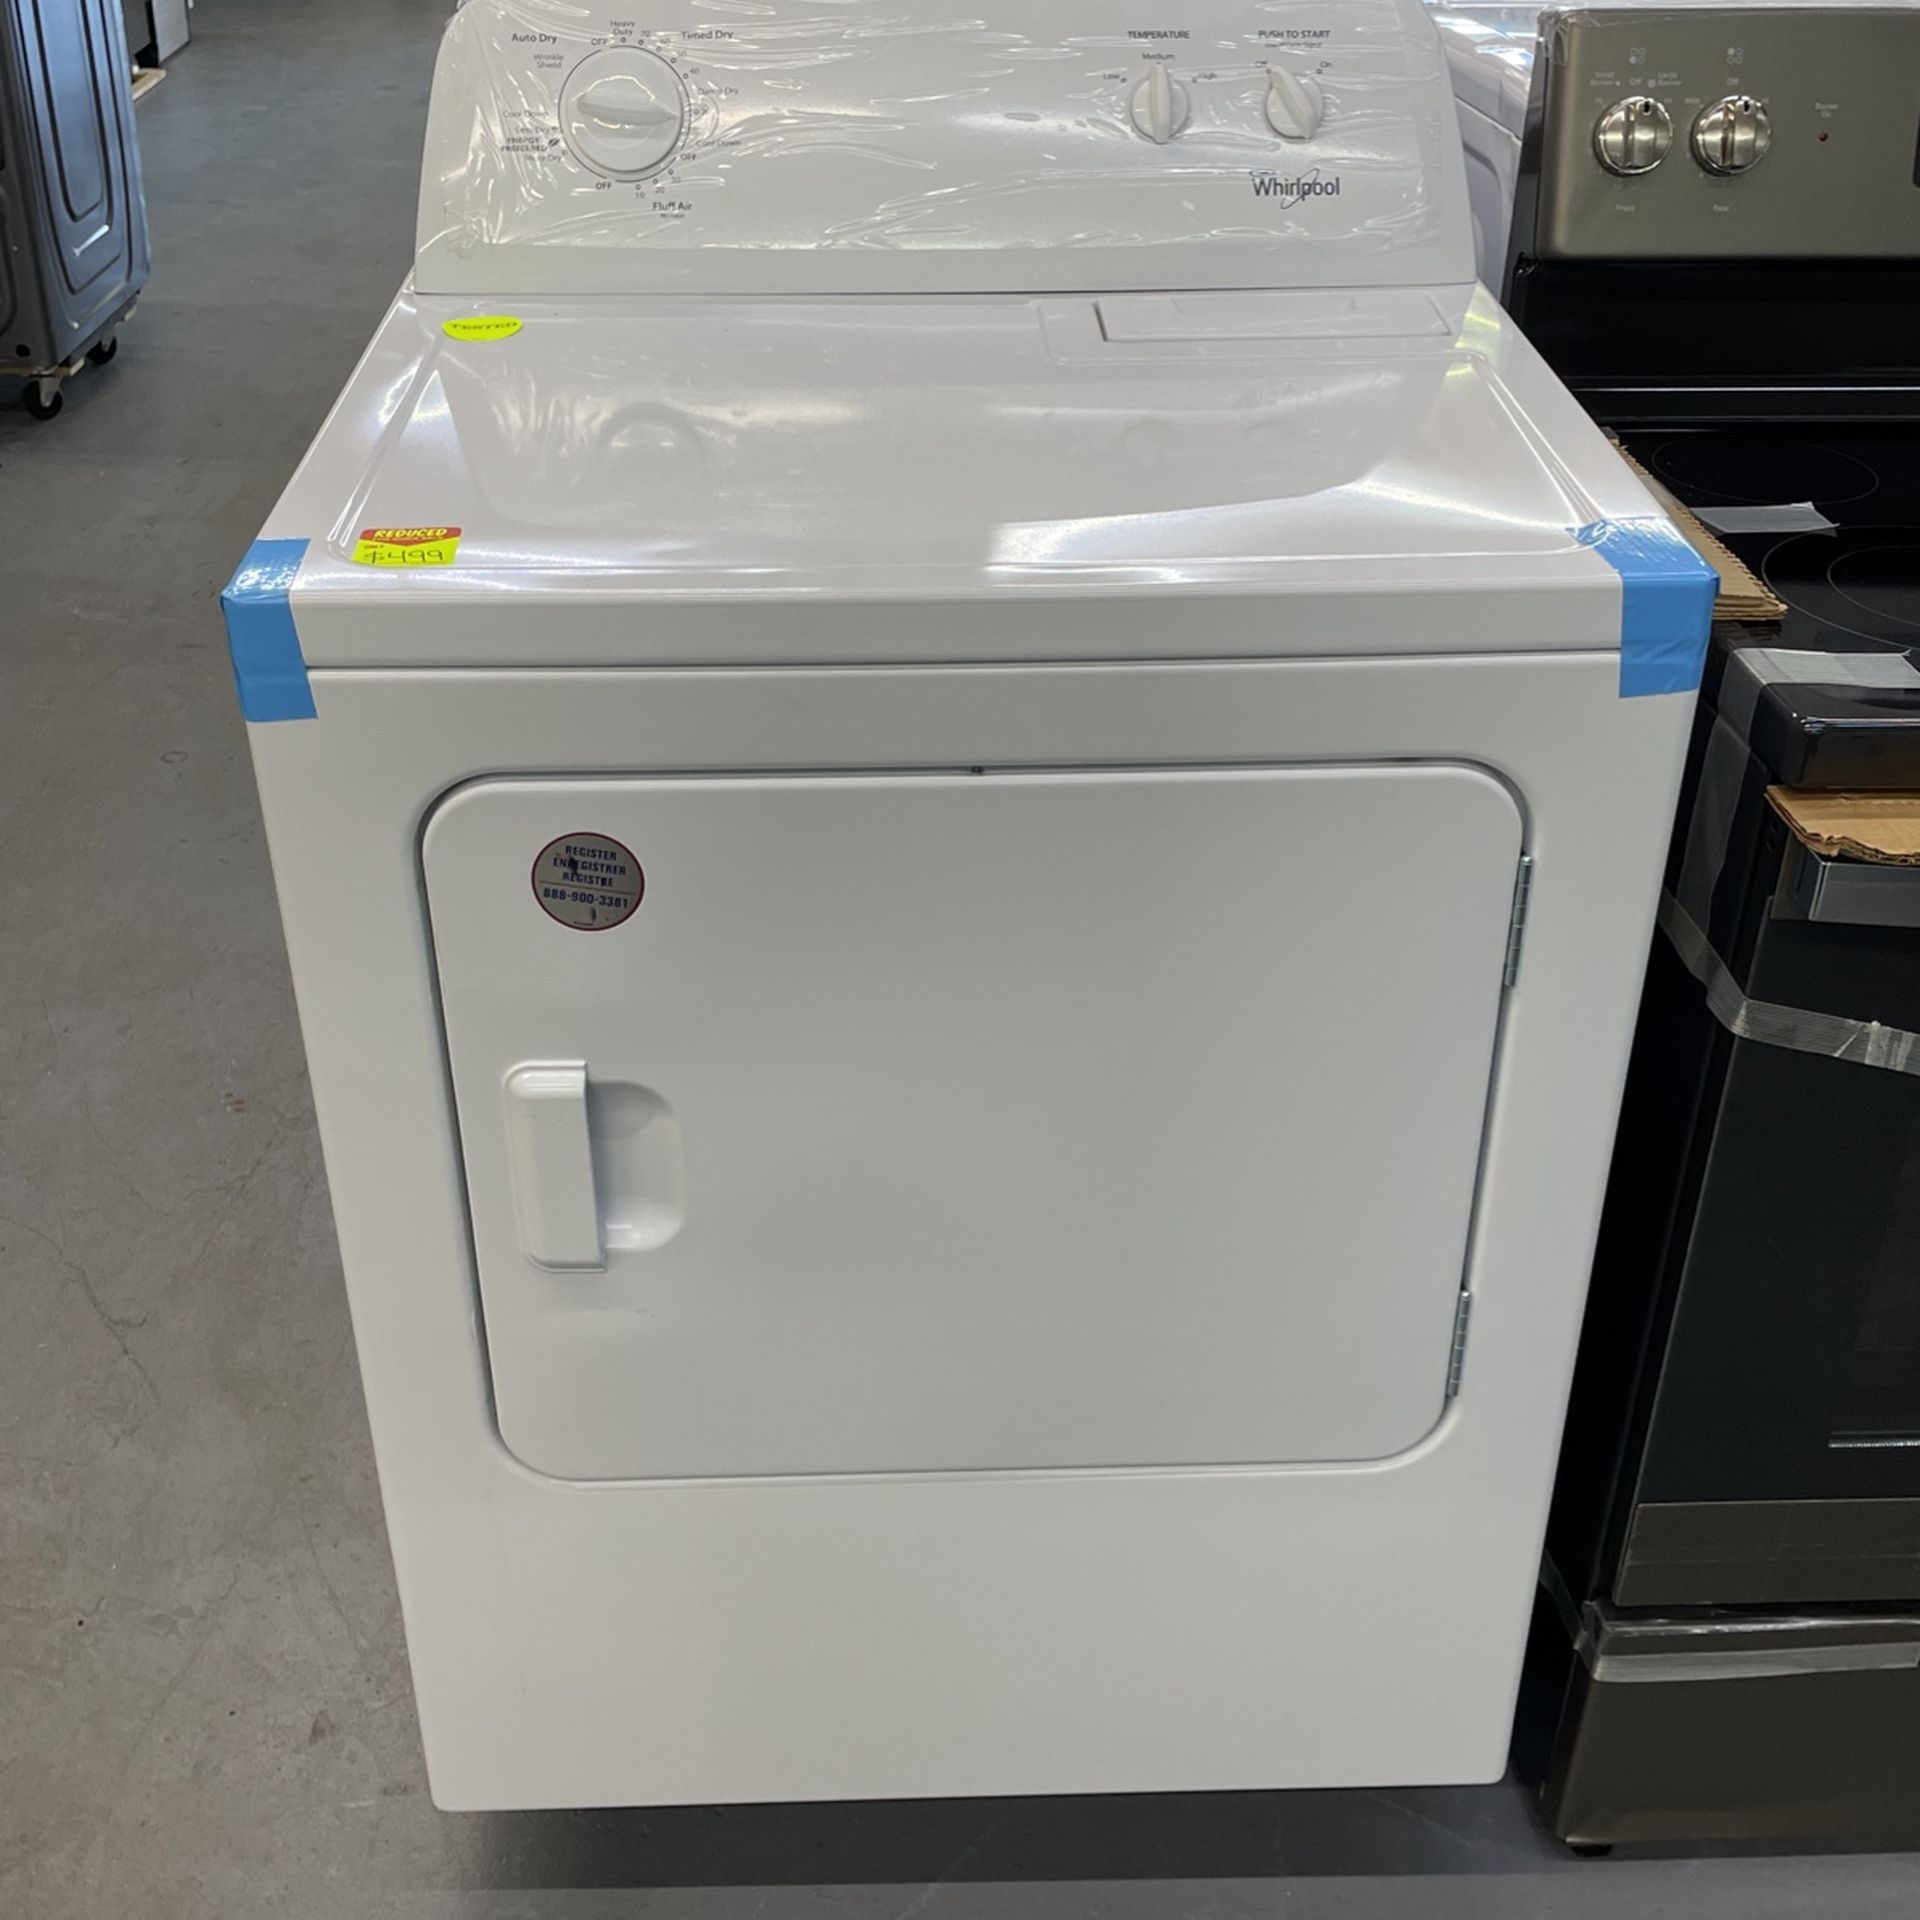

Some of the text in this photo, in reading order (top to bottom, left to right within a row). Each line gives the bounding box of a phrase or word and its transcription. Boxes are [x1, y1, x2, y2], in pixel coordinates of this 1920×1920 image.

[610, 20, 635, 28] Heavy
[613, 28, 633, 37] Duty
[681, 30, 734, 40] Timed Dry
[1127, 30, 1191, 39] TEMPERATURE
[1258, 30, 1331, 39] PUSH TO START
[511, 33, 557, 44] Auto Dry
[533, 53, 564, 61] Wrinkle
[1320, 60, 1332, 68] On
[595, 182, 612, 190] OFF
[1251, 176, 1341, 202] Whirlpool
[652, 201, 693, 211] Fluff Air
[374, 528, 449, 538] REDUCED
[363, 549, 443, 564] $499
[565, 845, 617, 861] REGISTER
[562, 871, 614, 888] REGISTRE
[543, 887, 629, 909] 888-900-3381
